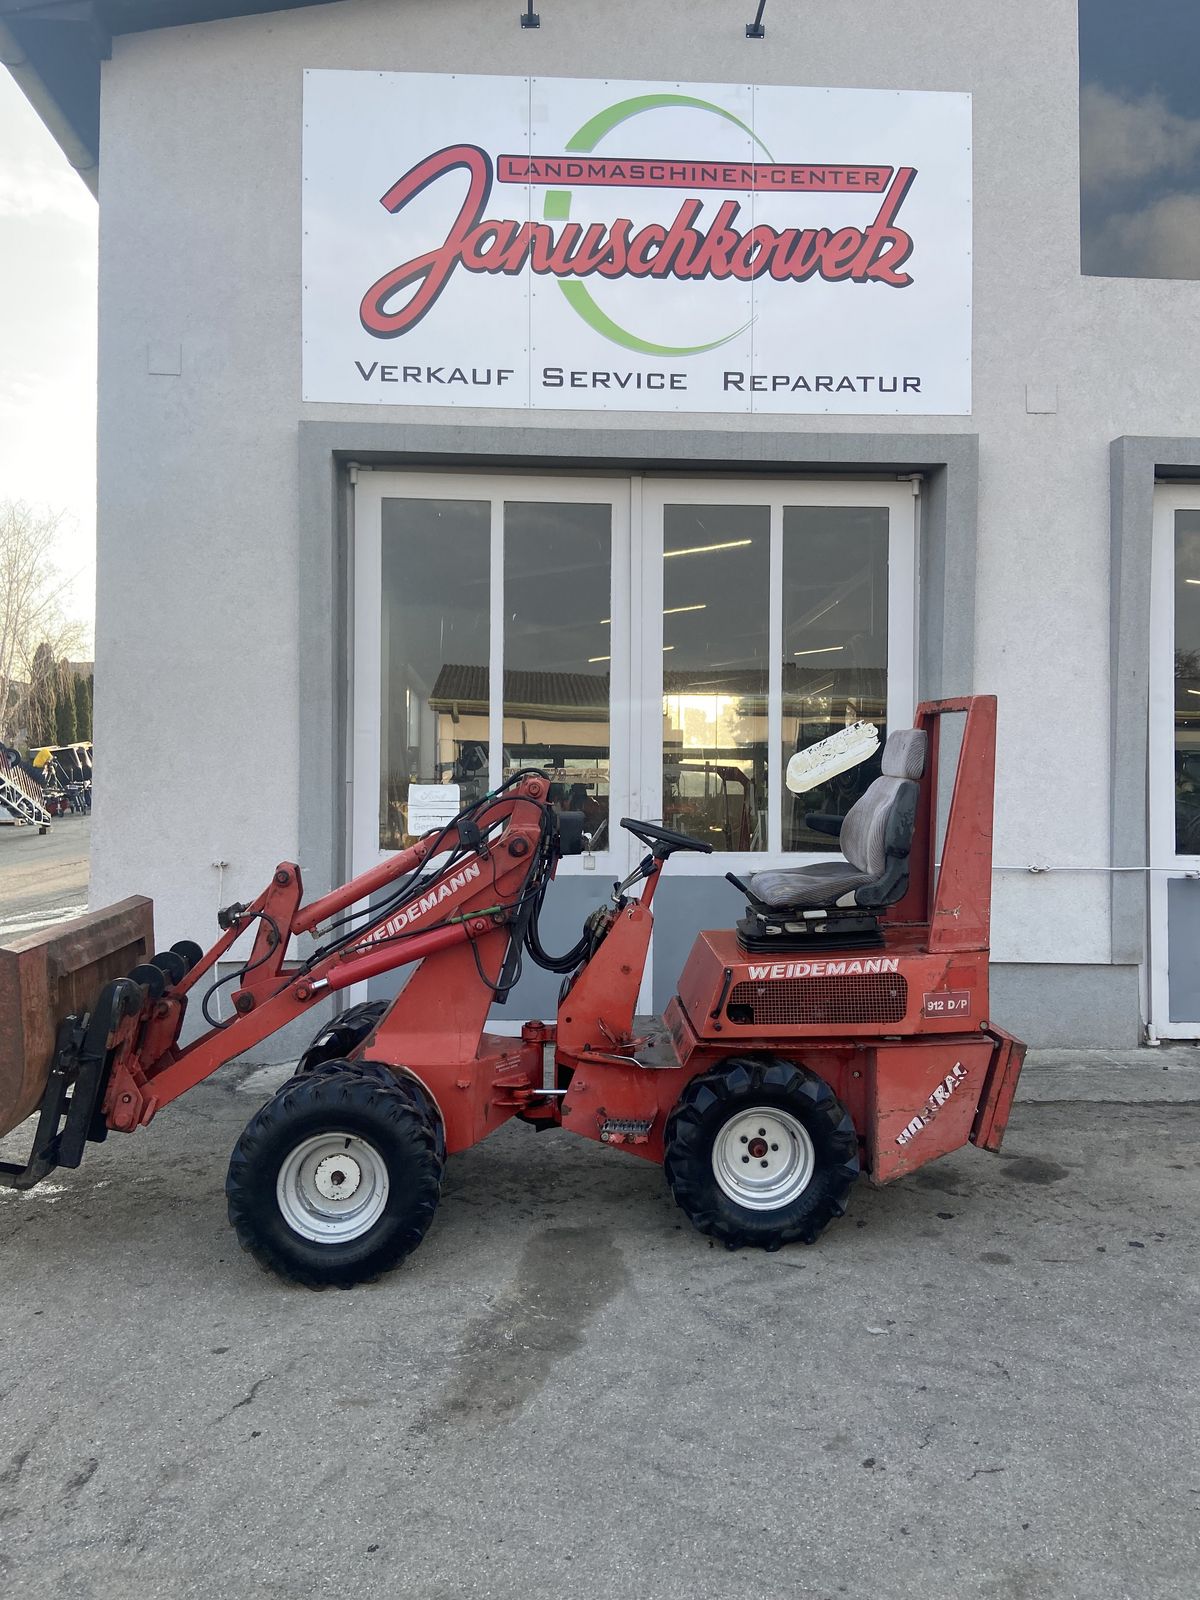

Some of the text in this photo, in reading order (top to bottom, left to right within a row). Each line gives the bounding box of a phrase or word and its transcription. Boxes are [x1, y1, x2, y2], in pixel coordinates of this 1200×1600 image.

[507, 161, 881, 186] LANDMASCHINEN-CENTER
[354, 361, 922, 393] VERKAUF SERVICE REPARATUR
[354, 862, 481, 955] WEIDEMANN
[748, 958, 900, 980] WEIDEMANN
[927, 999, 968, 1011] 912 D/P
[894, 1061, 970, 1146] HOTRAC
